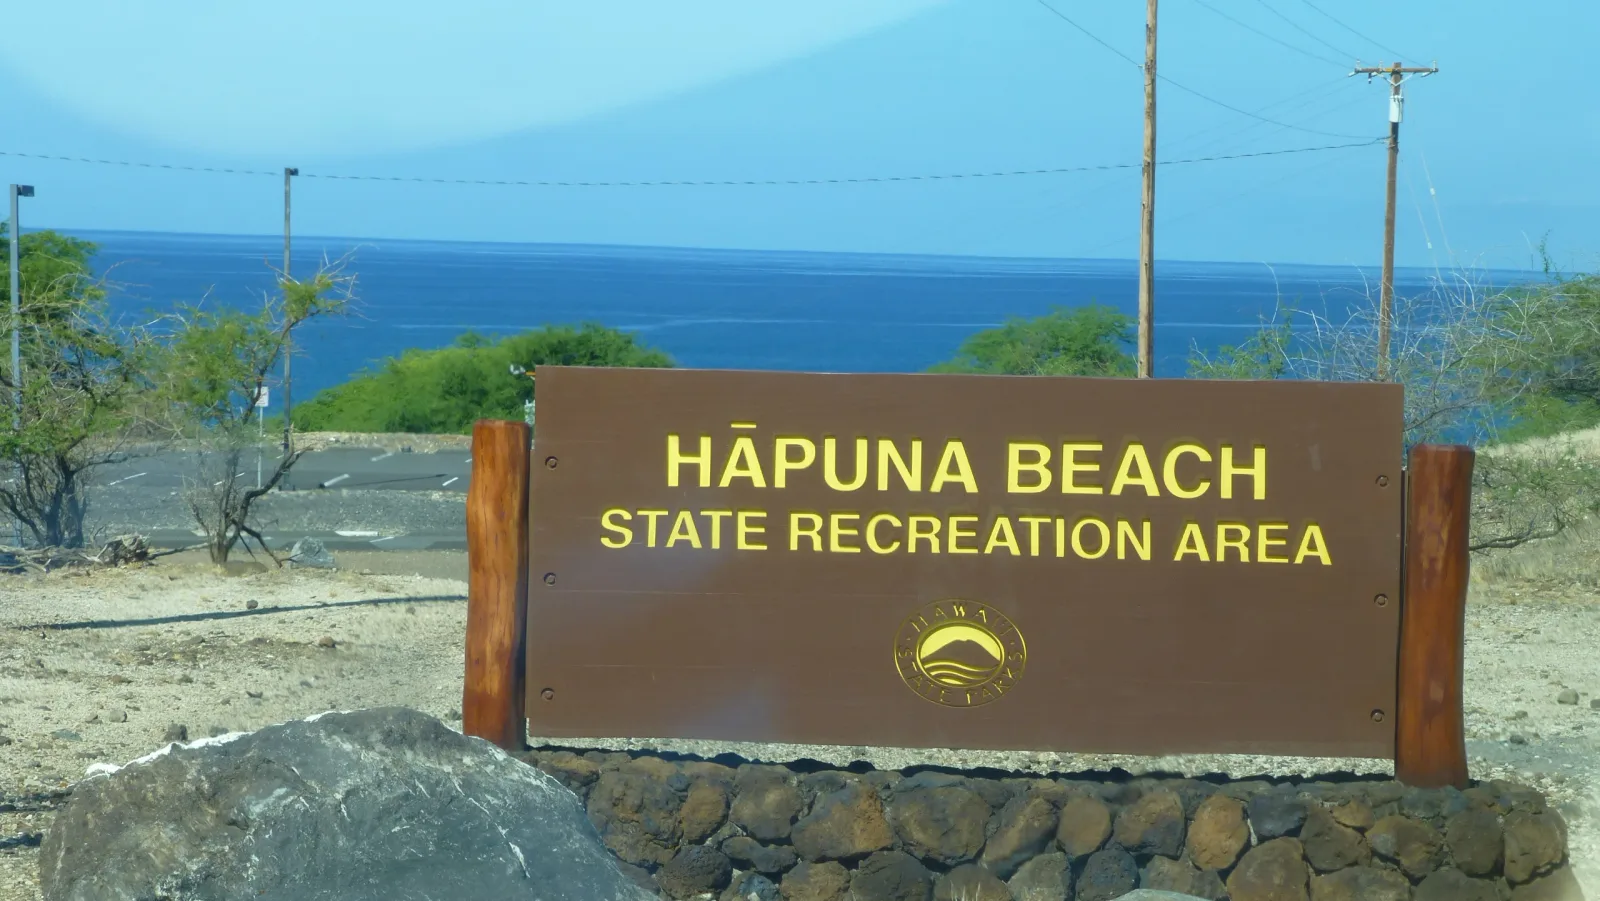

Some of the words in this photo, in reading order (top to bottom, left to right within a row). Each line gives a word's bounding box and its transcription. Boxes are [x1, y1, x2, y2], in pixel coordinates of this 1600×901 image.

[666, 422, 979, 494] HĀPUNA
[1007, 442, 1267, 501] BEACH
[600, 508, 769, 551] STATE
[789, 512, 1152, 562] RECREATION
[1173, 522, 1333, 567] AREA
